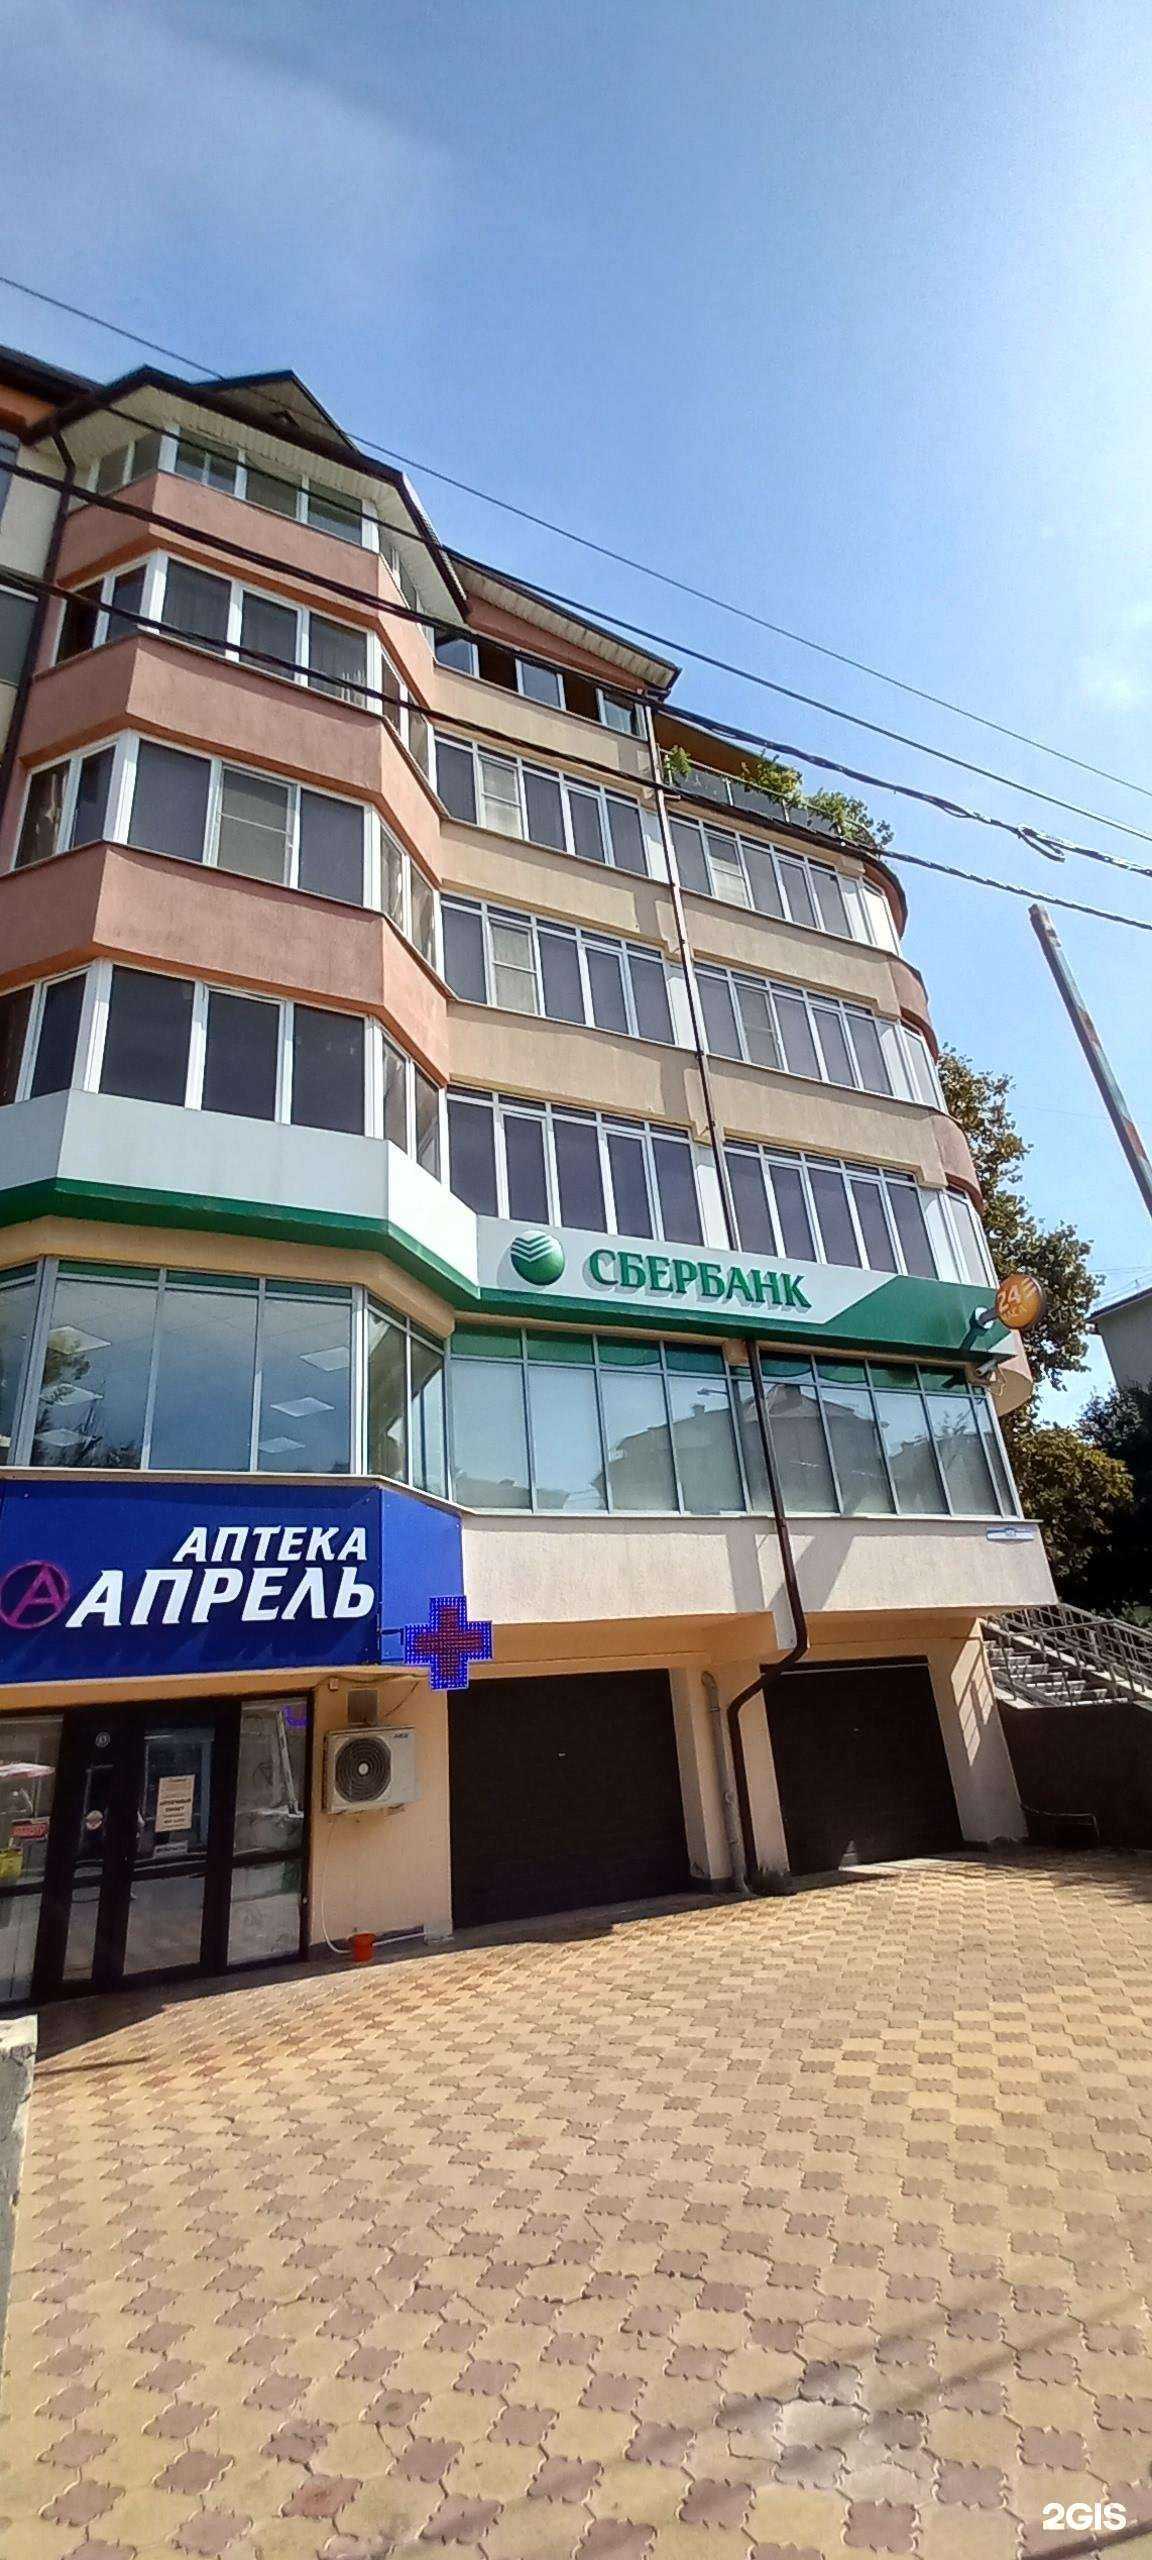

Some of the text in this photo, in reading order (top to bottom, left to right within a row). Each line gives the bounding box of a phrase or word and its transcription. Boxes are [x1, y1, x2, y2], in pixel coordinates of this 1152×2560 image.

[589, 1249, 812, 1309] СБЕРБАНК
[172, 1525, 367, 1563] АПТЕКА
[65, 1567, 375, 1628] АПРЕЛЬ
